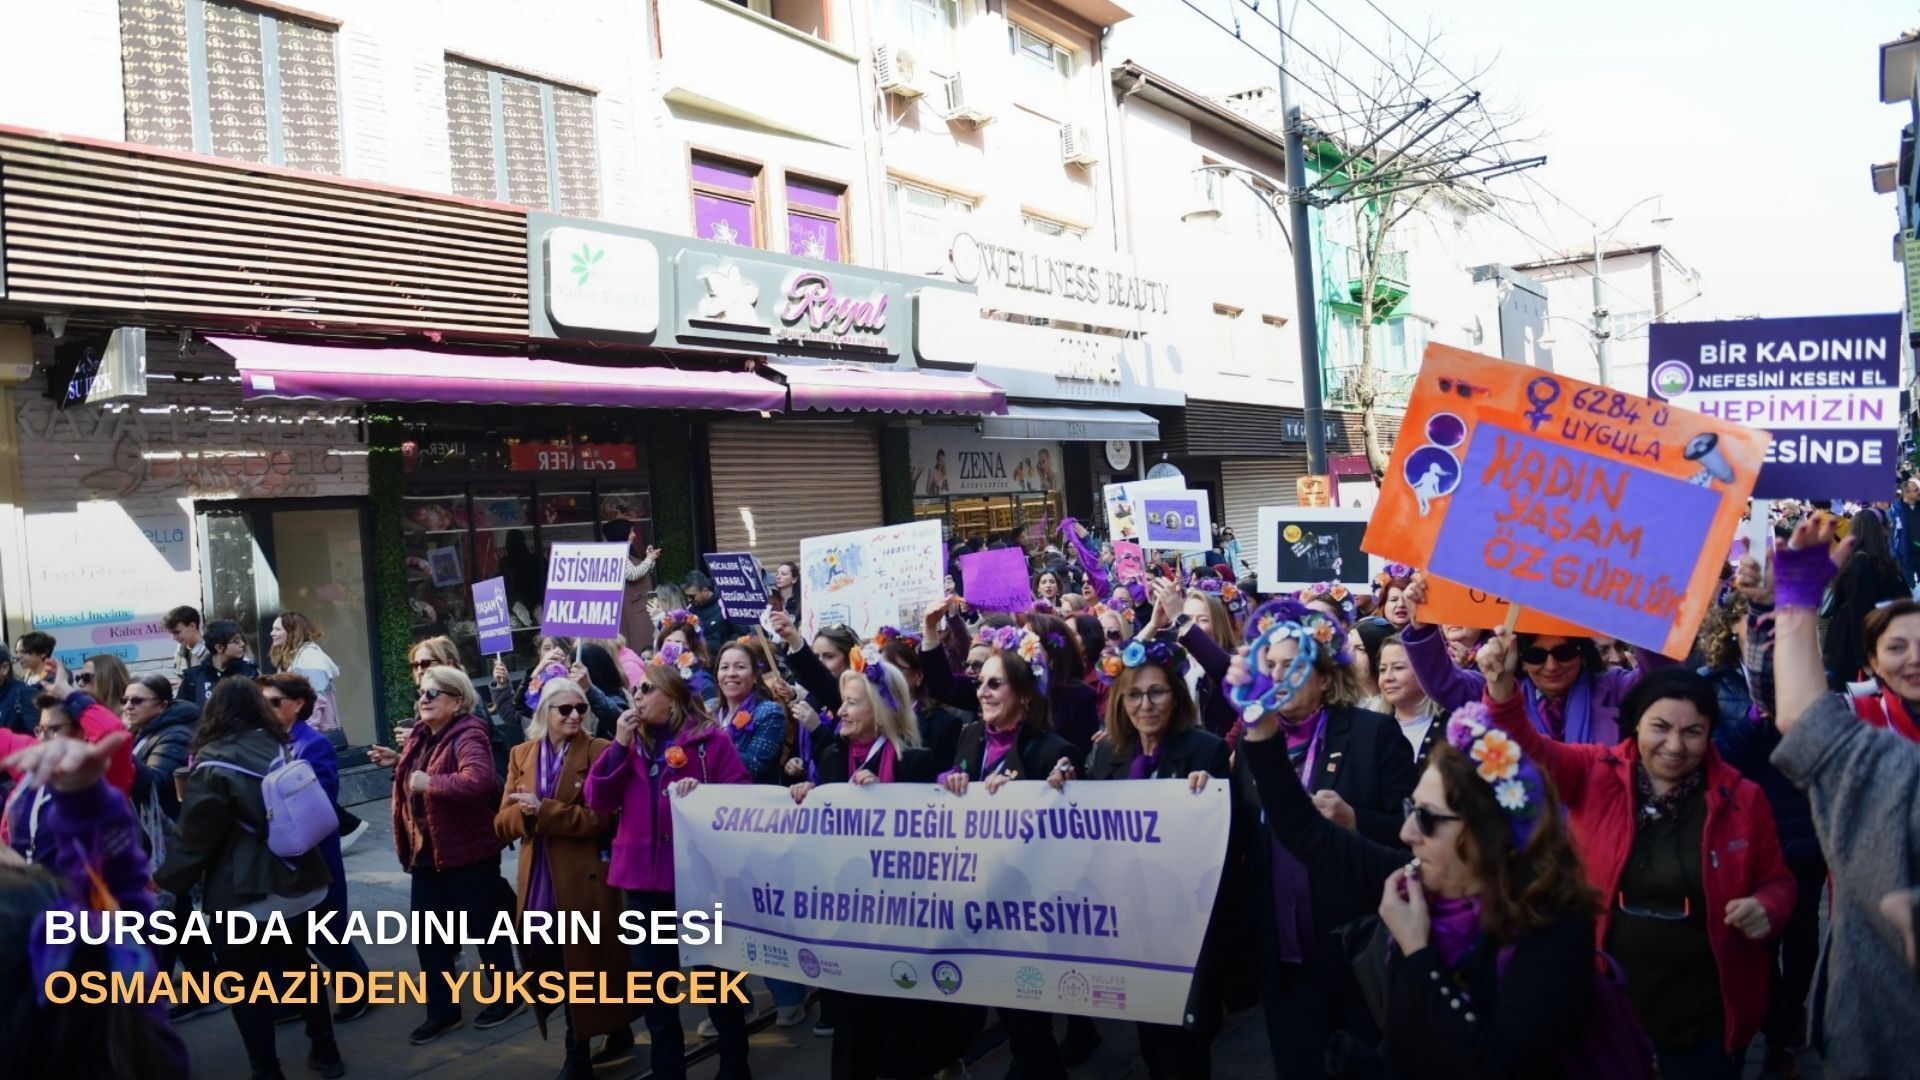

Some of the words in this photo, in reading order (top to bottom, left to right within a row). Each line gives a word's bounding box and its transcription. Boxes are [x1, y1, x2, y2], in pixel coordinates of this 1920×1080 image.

[977, 242, 1099, 303] WELLNESS
[1105, 270, 1168, 314] BEAUTY
[780, 271, 888, 334] Royal
[1700, 340, 1747, 364] BİR
[1757, 338, 1886, 362] KADININ
[1699, 371, 1784, 388] NEFESİNİ
[1790, 371, 1855, 387] KESEN
[1862, 370, 1886, 385] EL
[1700, 395, 1883, 421] HEPİMİZİN
[1561, 416, 1661, 461] UYGULA
[1763, 436, 1882, 465] ESİNDE
[958, 451, 1007, 480] ZENA
[1481, 435, 1630, 512] KADIN
[1494, 491, 1642, 558] YAŞAM
[551, 551, 624, 583] İSTİSMARI
[1484, 524, 1690, 626] ÖZGÜRLÜK
[146, 623, 165, 635] Ma
[546, 600, 617, 625] AKLAMA!
[712, 803, 884, 837] SAKLANDIĞIMIZ
[893, 803, 956, 840] DEĞİL
[964, 801, 1161, 844] BULUŞTUĞUMUZ
[869, 847, 977, 882] YERDEYİZ!
[752, 885, 785, 917] BİZ
[793, 887, 954, 930] BİRBİRİMİZİN
[964, 896, 1119, 938] ÇARESİYİZ!
